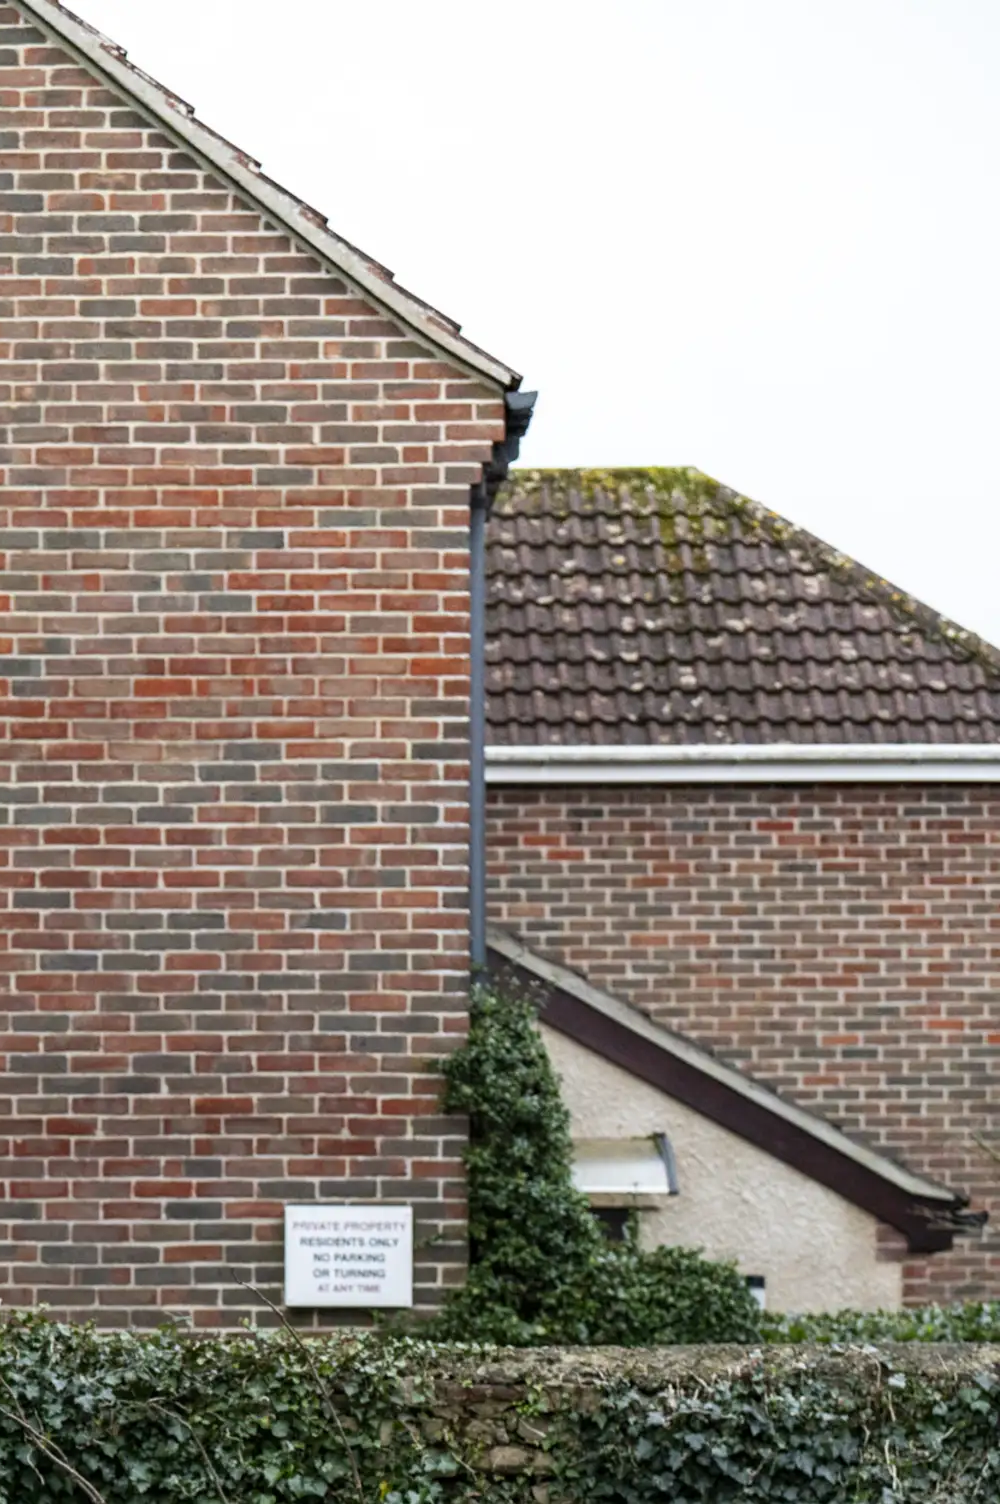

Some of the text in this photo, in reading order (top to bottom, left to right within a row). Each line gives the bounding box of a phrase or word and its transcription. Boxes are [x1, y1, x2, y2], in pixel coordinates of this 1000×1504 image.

[292, 1222, 407, 1231] PRIVATE PROPERTY
[299, 1238, 399, 1247] RESIDENTS ONLY
[313, 1253, 385, 1262] NO PARKING
[313, 1269, 385, 1278] OR TURNING
[318, 1284, 381, 1293] AT ANY TIME
